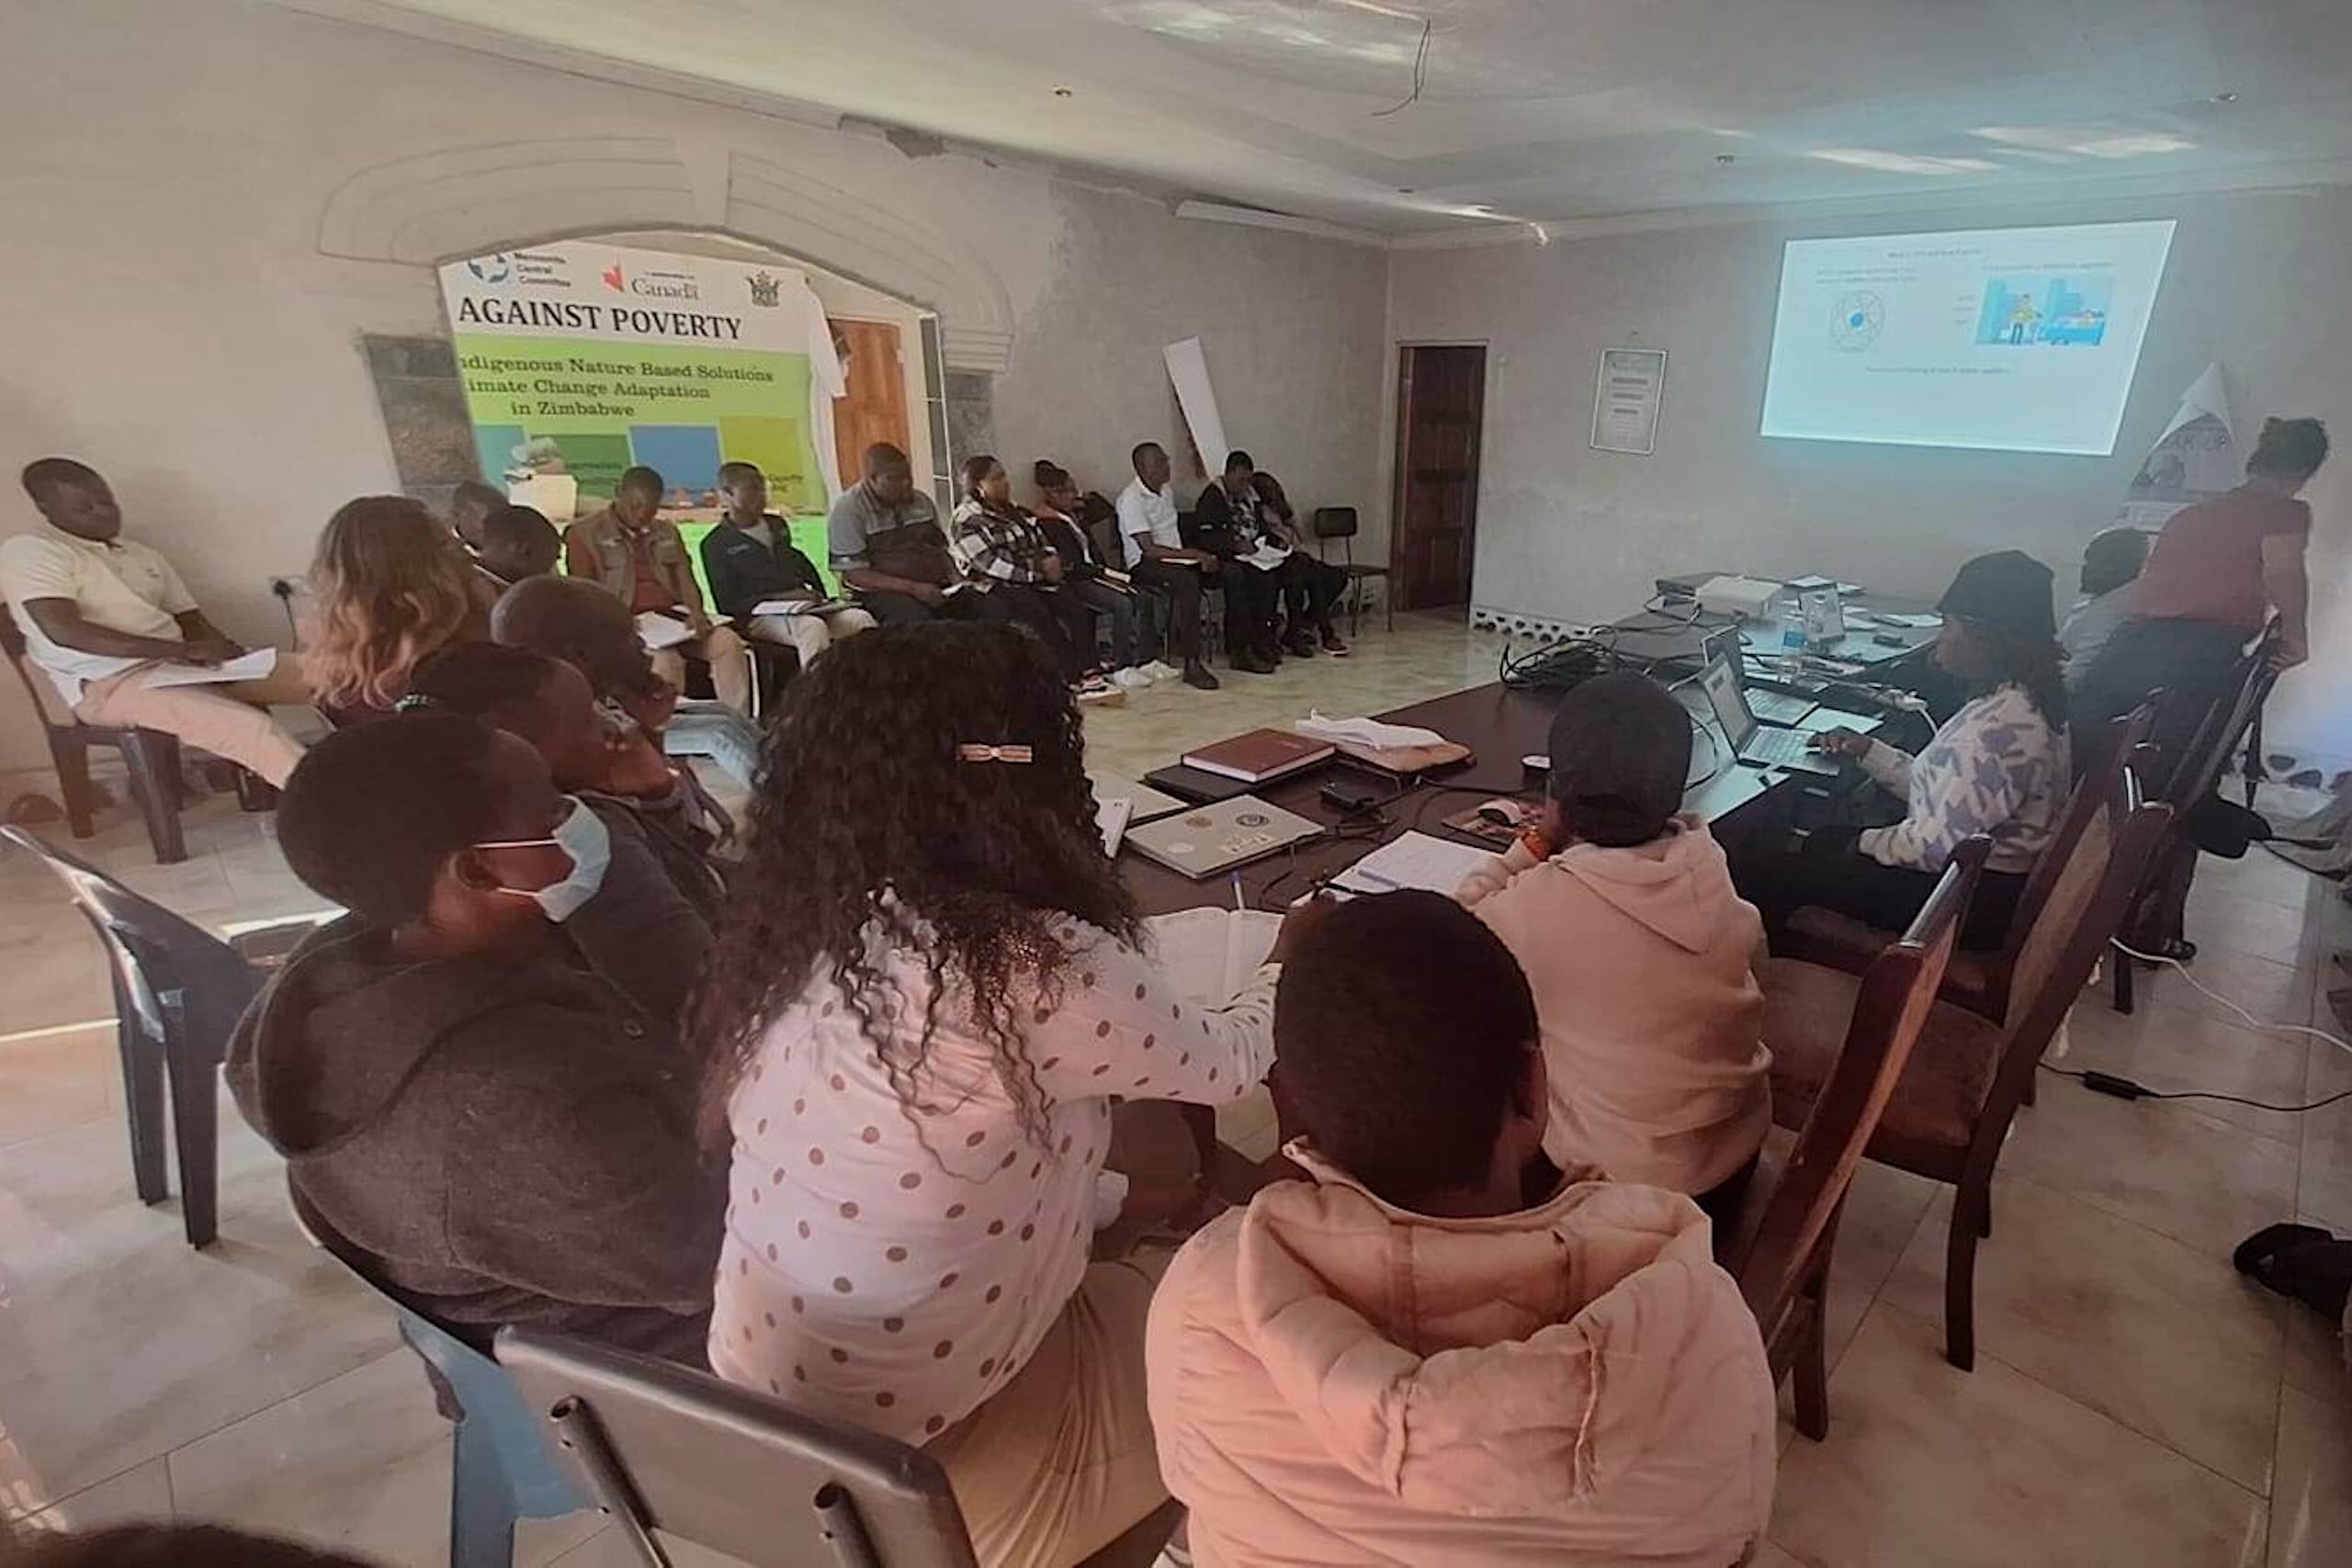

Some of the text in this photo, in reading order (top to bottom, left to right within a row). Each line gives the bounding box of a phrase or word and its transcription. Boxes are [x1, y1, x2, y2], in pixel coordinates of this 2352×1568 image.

[631, 277, 699, 300] Canada
[459, 297, 741, 340] AGAINST POVERTY
[569, 358, 635, 376] Nature
[641, 362, 691, 378] Based
[697, 365, 774, 382] Solutions
[534, 379, 608, 397] Change
[614, 382, 710, 400] Adaptation
[511, 400, 635, 416] in Zimbabwe
